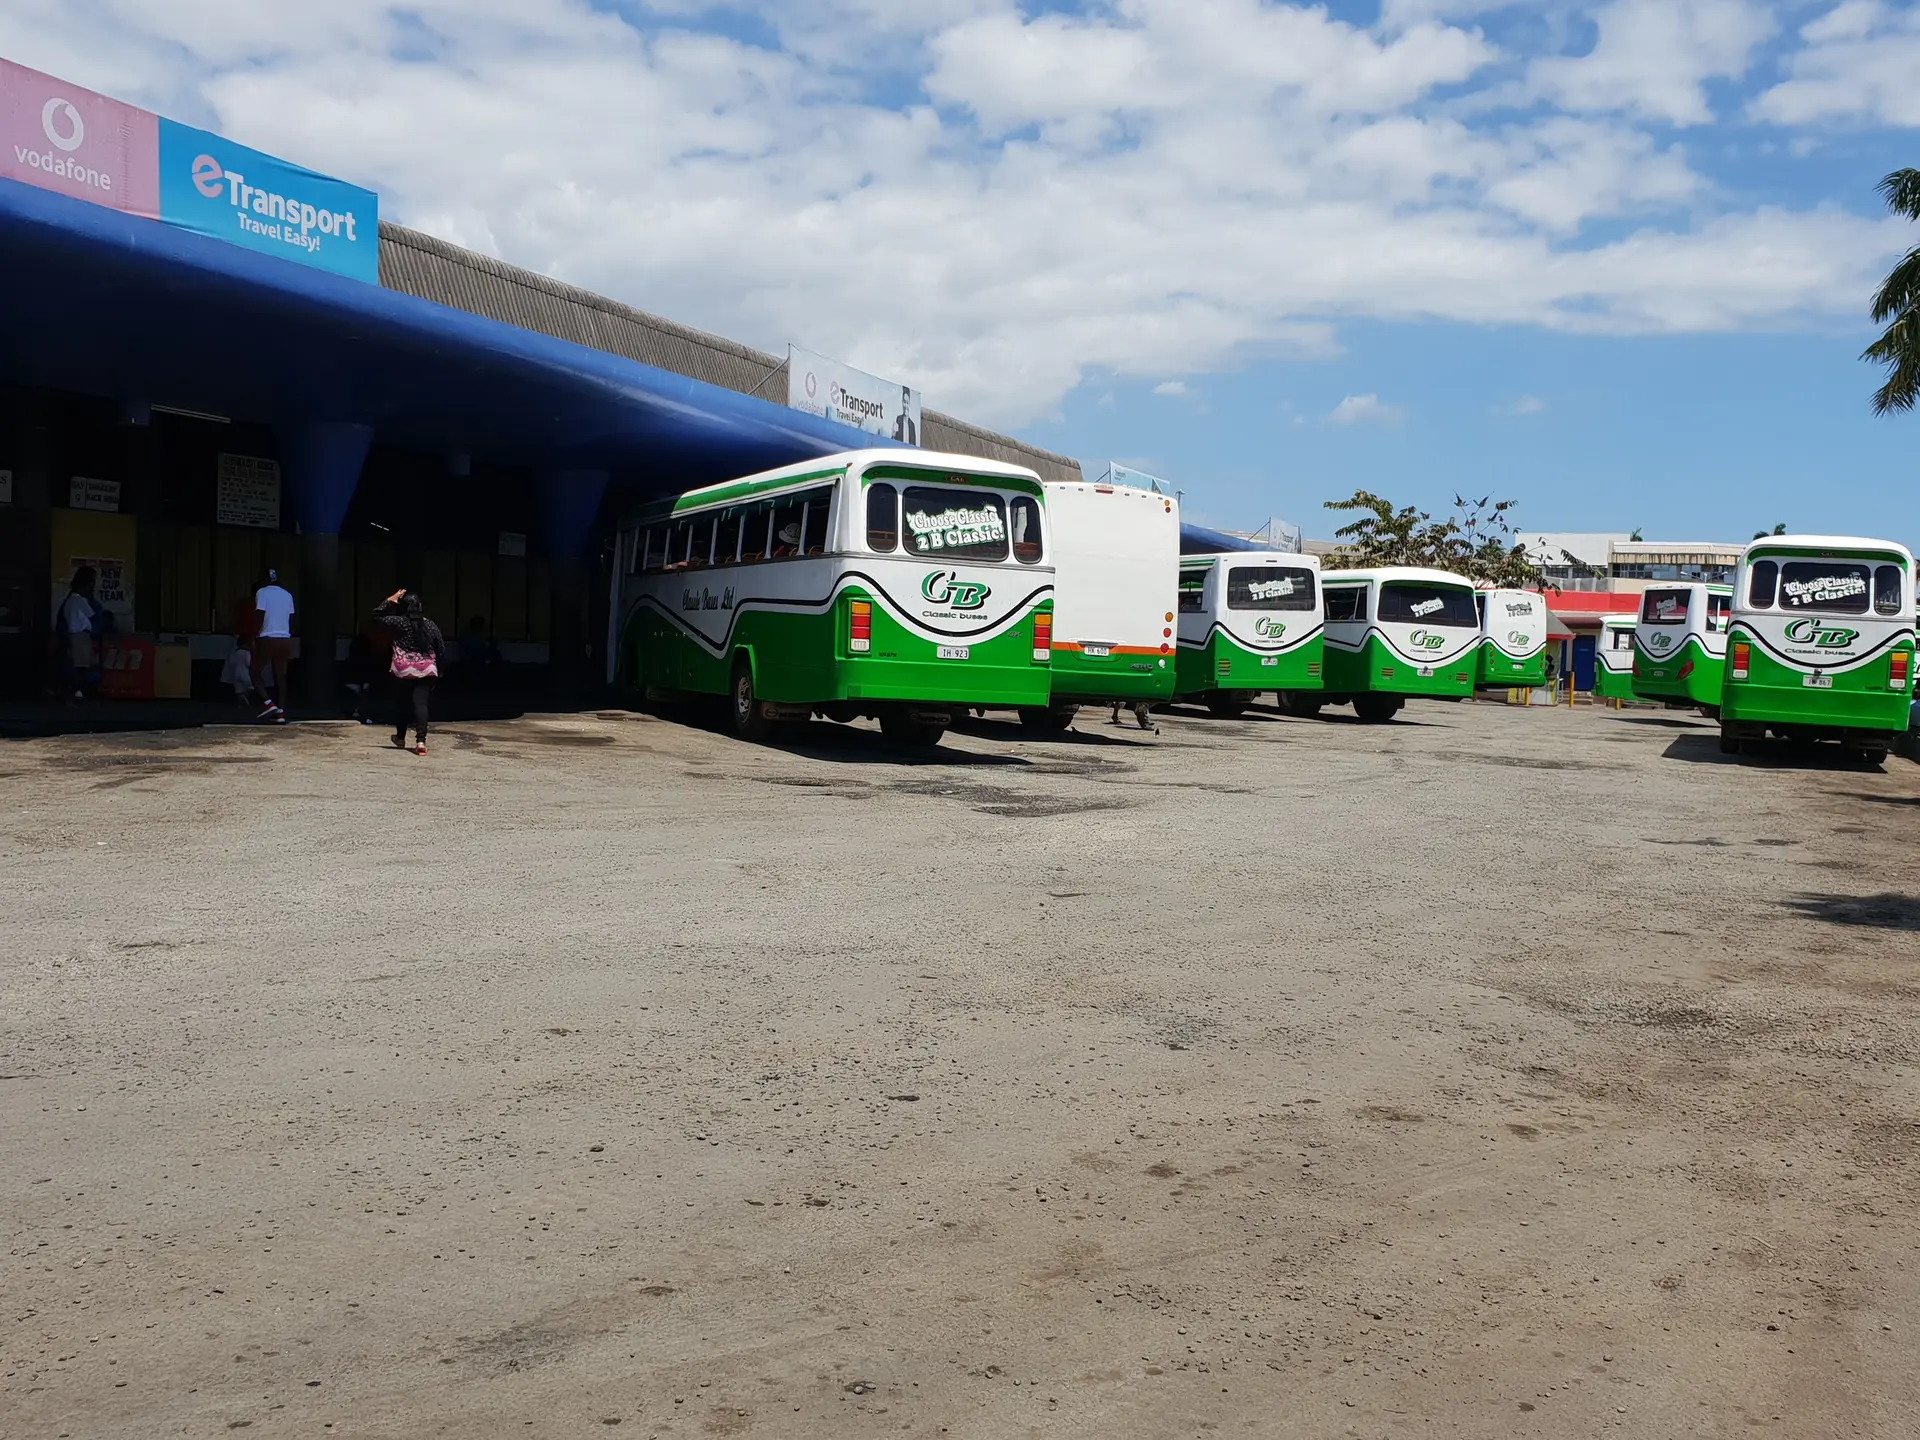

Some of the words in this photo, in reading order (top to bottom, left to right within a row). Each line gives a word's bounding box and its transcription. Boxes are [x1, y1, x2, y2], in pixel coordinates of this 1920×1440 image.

[14, 145, 111, 190] vodafone
[237, 212, 281, 240] Travel
[284, 226, 321, 253] Easy!
[836, 409, 851, 421] Travel
[914, 512, 957, 528] Choose
[957, 508, 997, 525] Classic
[917, 536, 929, 551] 2
[930, 532, 944, 549] B
[945, 525, 1005, 547] Classic!
[101, 568, 121, 578] NEW
[102, 580, 120, 590] CUP
[99, 591, 124, 601] TEAM
[1791, 597, 1800, 606] 2
[1802, 594, 1813, 604] B
[922, 610, 957, 619] Classic
[955, 649, 968, 658] 923
